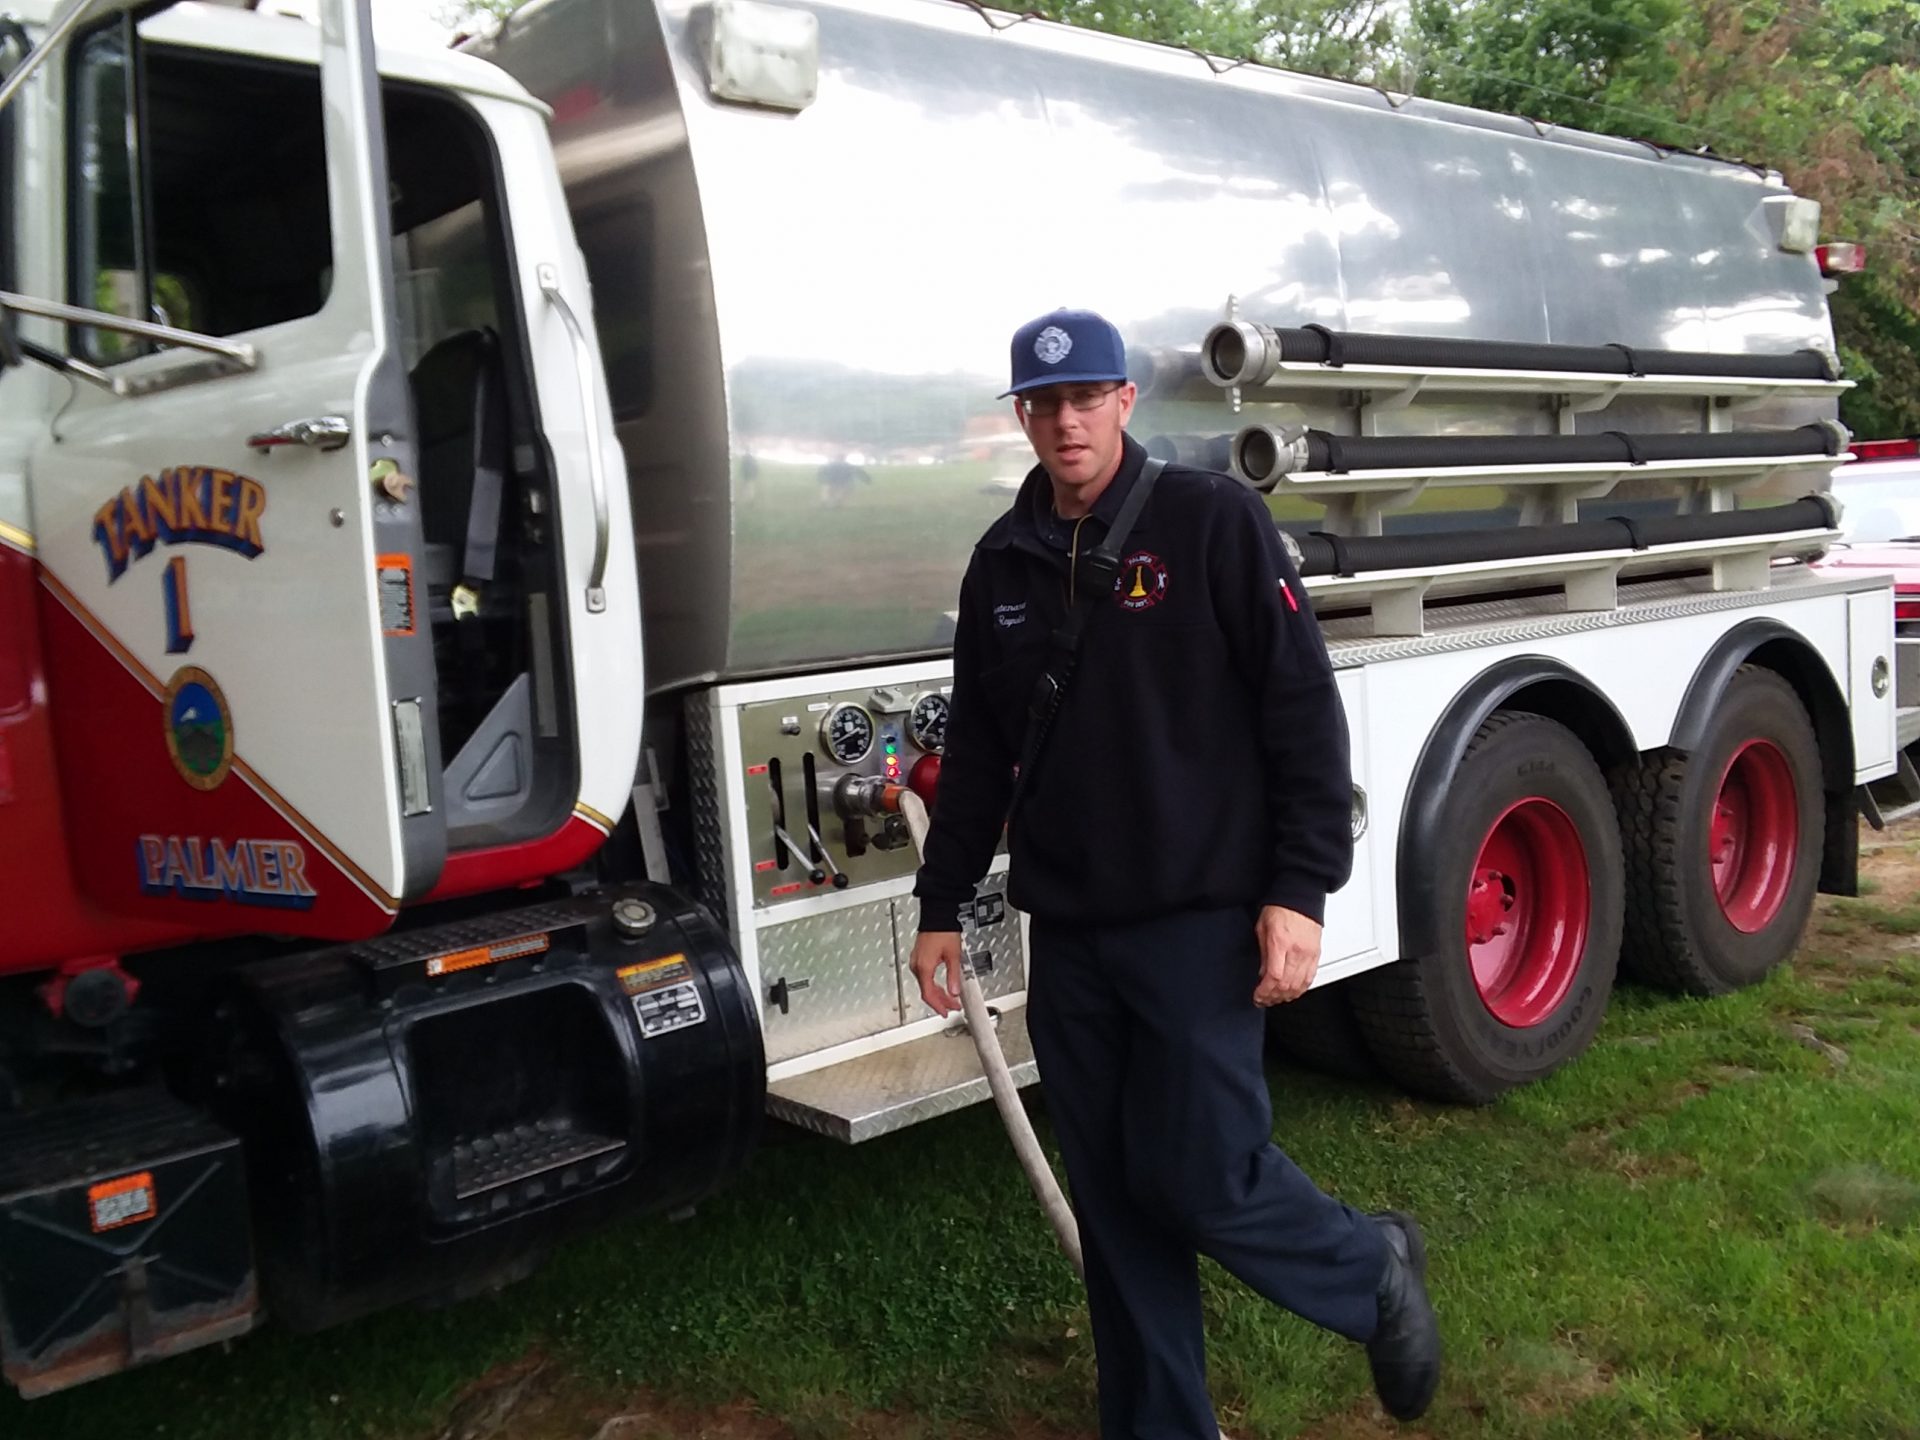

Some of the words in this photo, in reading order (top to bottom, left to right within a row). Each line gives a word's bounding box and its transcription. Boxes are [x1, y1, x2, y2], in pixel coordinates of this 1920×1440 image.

[92, 465, 266, 584] TANKER
[163, 556, 194, 654] 1
[137, 834, 317, 910] PALMER
